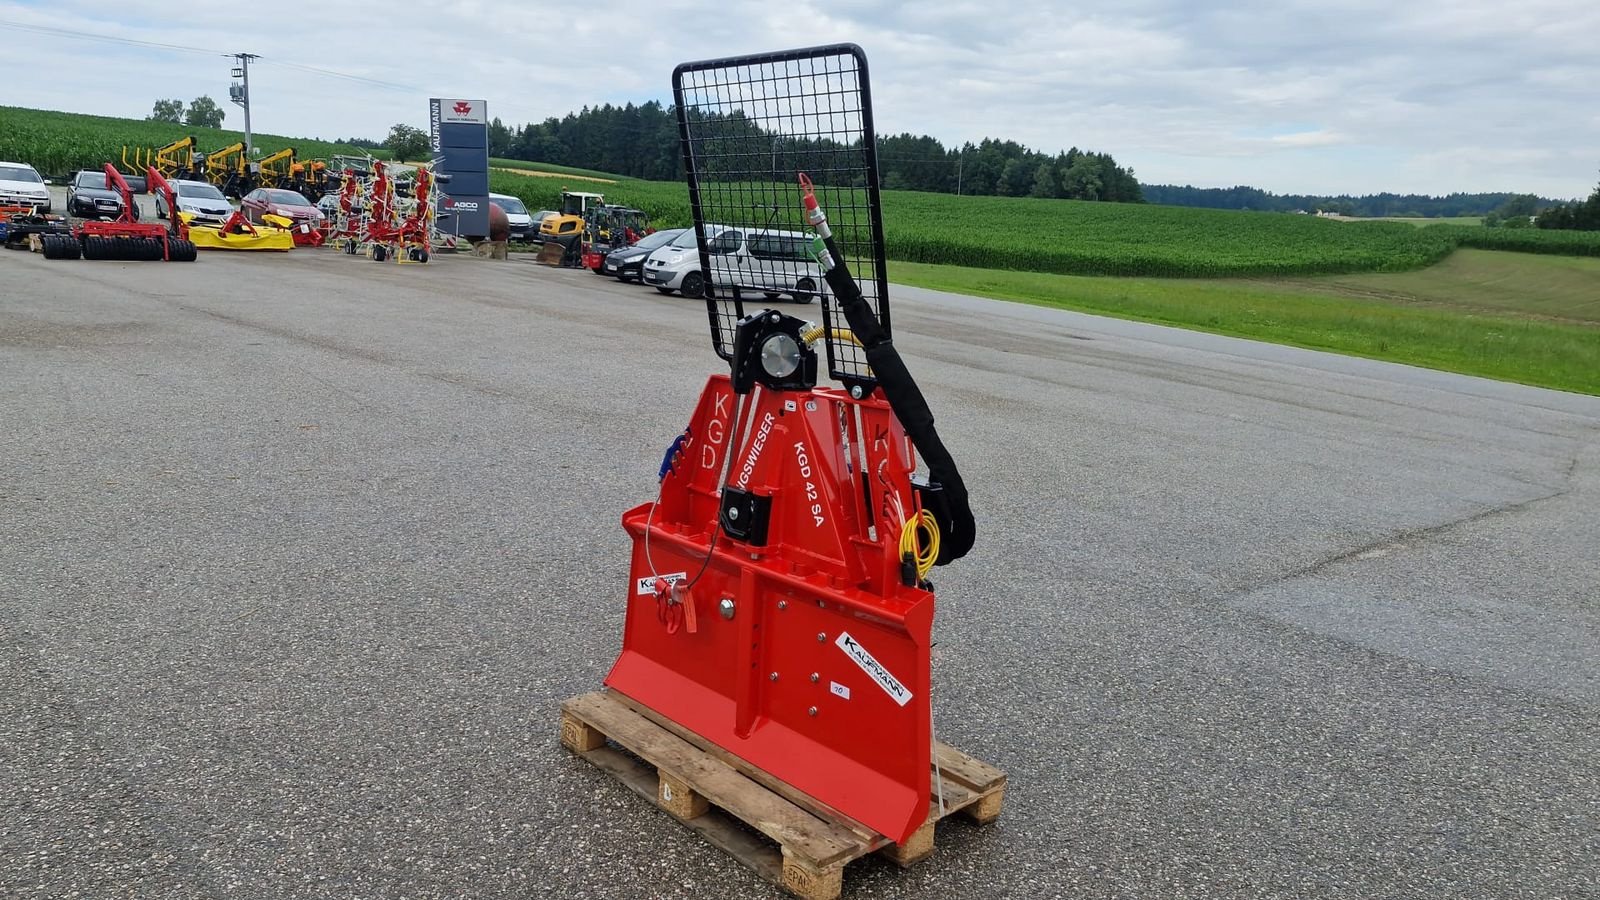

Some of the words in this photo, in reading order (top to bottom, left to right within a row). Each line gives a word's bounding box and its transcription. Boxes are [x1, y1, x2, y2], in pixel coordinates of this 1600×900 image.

[432, 103, 440, 152] KAUFMANN
[702, 391, 728, 469] KGD
[794, 442, 811, 478] KGD
[806, 481, 818, 501] 42
[811, 504, 824, 527] SA
[844, 636, 904, 697] KAUFMANN
